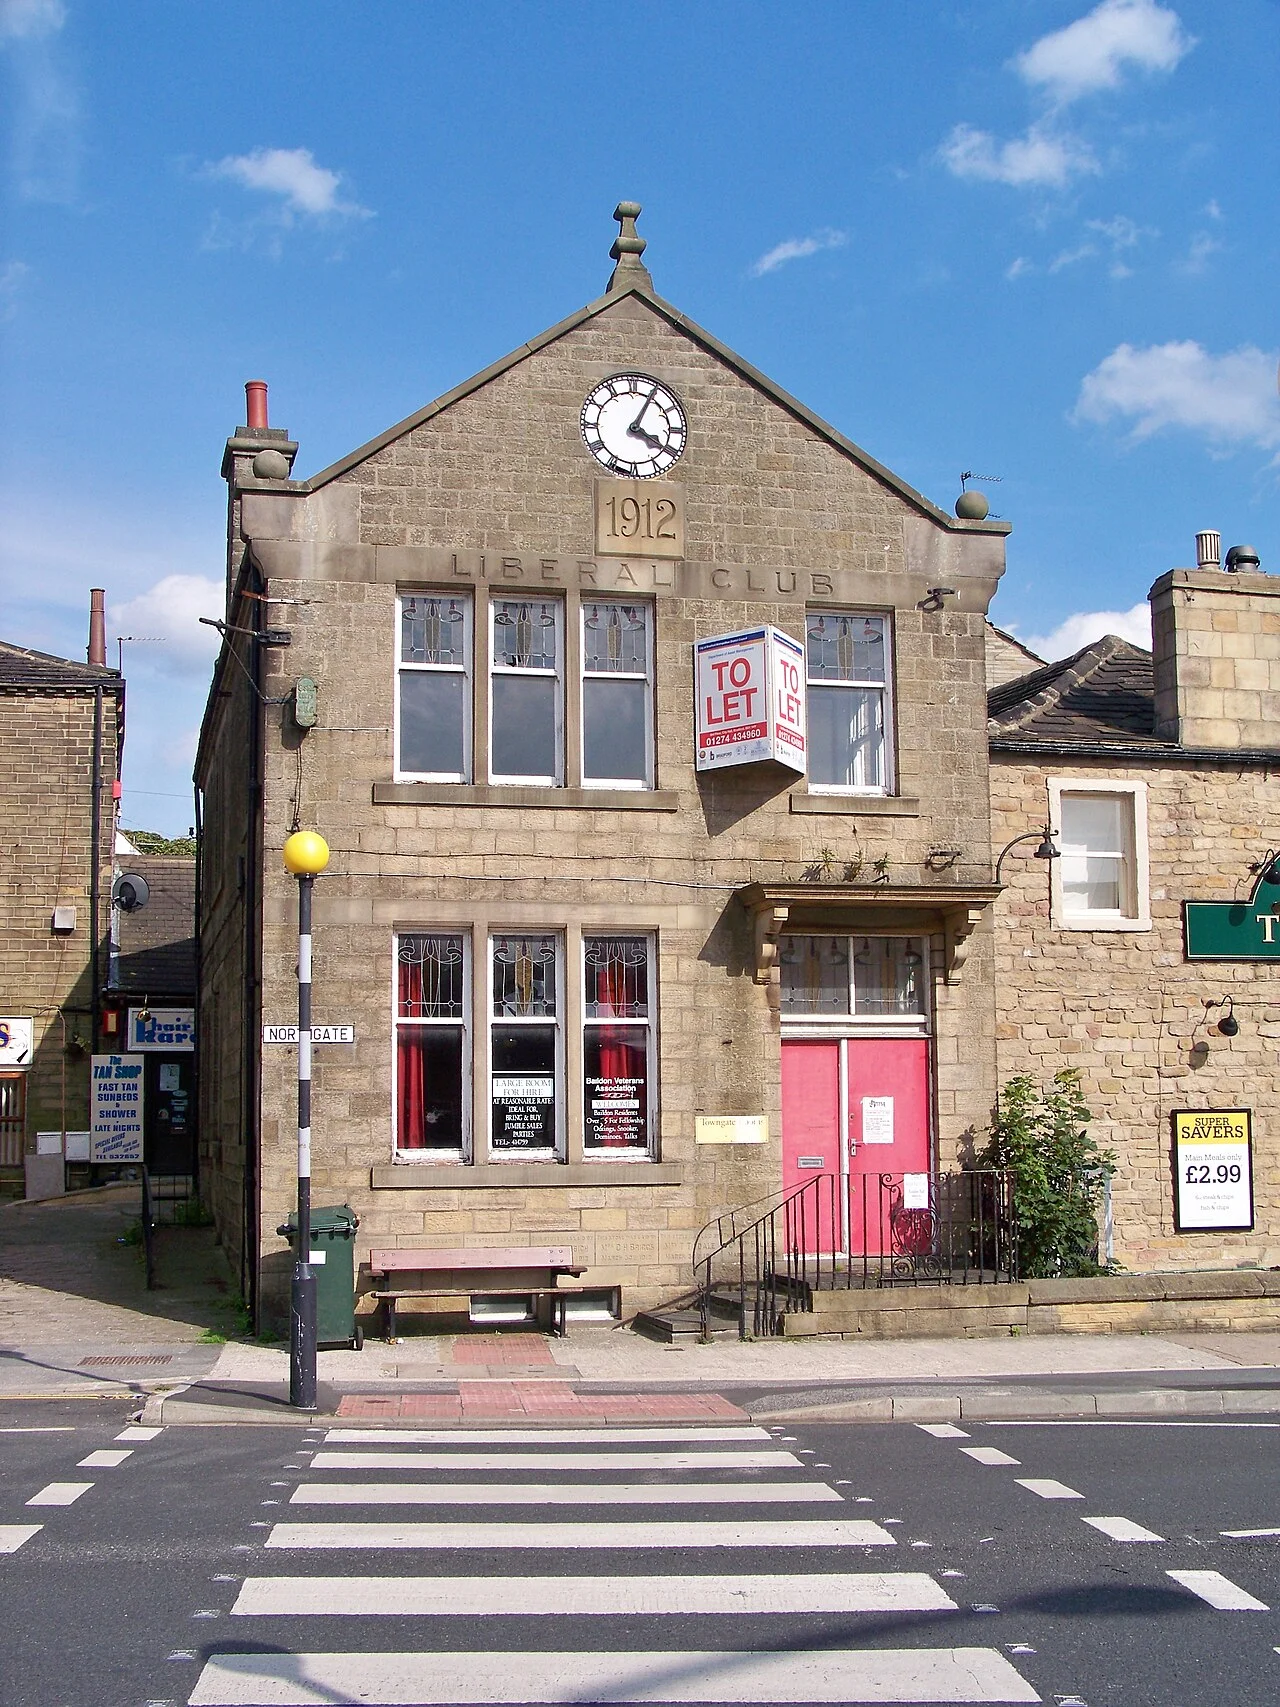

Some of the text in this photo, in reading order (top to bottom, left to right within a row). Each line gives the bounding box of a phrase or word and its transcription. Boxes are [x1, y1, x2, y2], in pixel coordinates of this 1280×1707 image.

[605, 497, 676, 540] 1912
[451, 554, 834, 597] LIBERAL CLUB
[711, 657, 751, 691] TO
[780, 659, 799, 694] TO
[706, 687, 758, 725] LET
[779, 689, 801, 727] LET
[706, 728, 761, 746] 01274 434960
[152, 1017, 191, 1031] hair
[269, 1028, 348, 1041] NORGATE
[109, 1056, 122, 1065] The
[93, 1065, 142, 1079] TAN SHOP
[98, 1083, 138, 1092] FAST TAN
[495, 1079, 551, 1087] LARGE ROOM
[614, 1077, 645, 1085] Veterans
[97, 1093, 139, 1102] SUNBEDS
[99, 1109, 137, 1118] SHOWER
[504, 1122, 525, 1131] JUMBLE
[618, 1116, 645, 1125] Fellowship
[700, 1117, 736, 1128] Towngate
[1195, 1117, 1230, 1127] SUPER
[1181, 1125, 1244, 1139] SAVERS
[1227, 1153, 1242, 1162] only
[1185, 1164, 1241, 1184] £2.99
